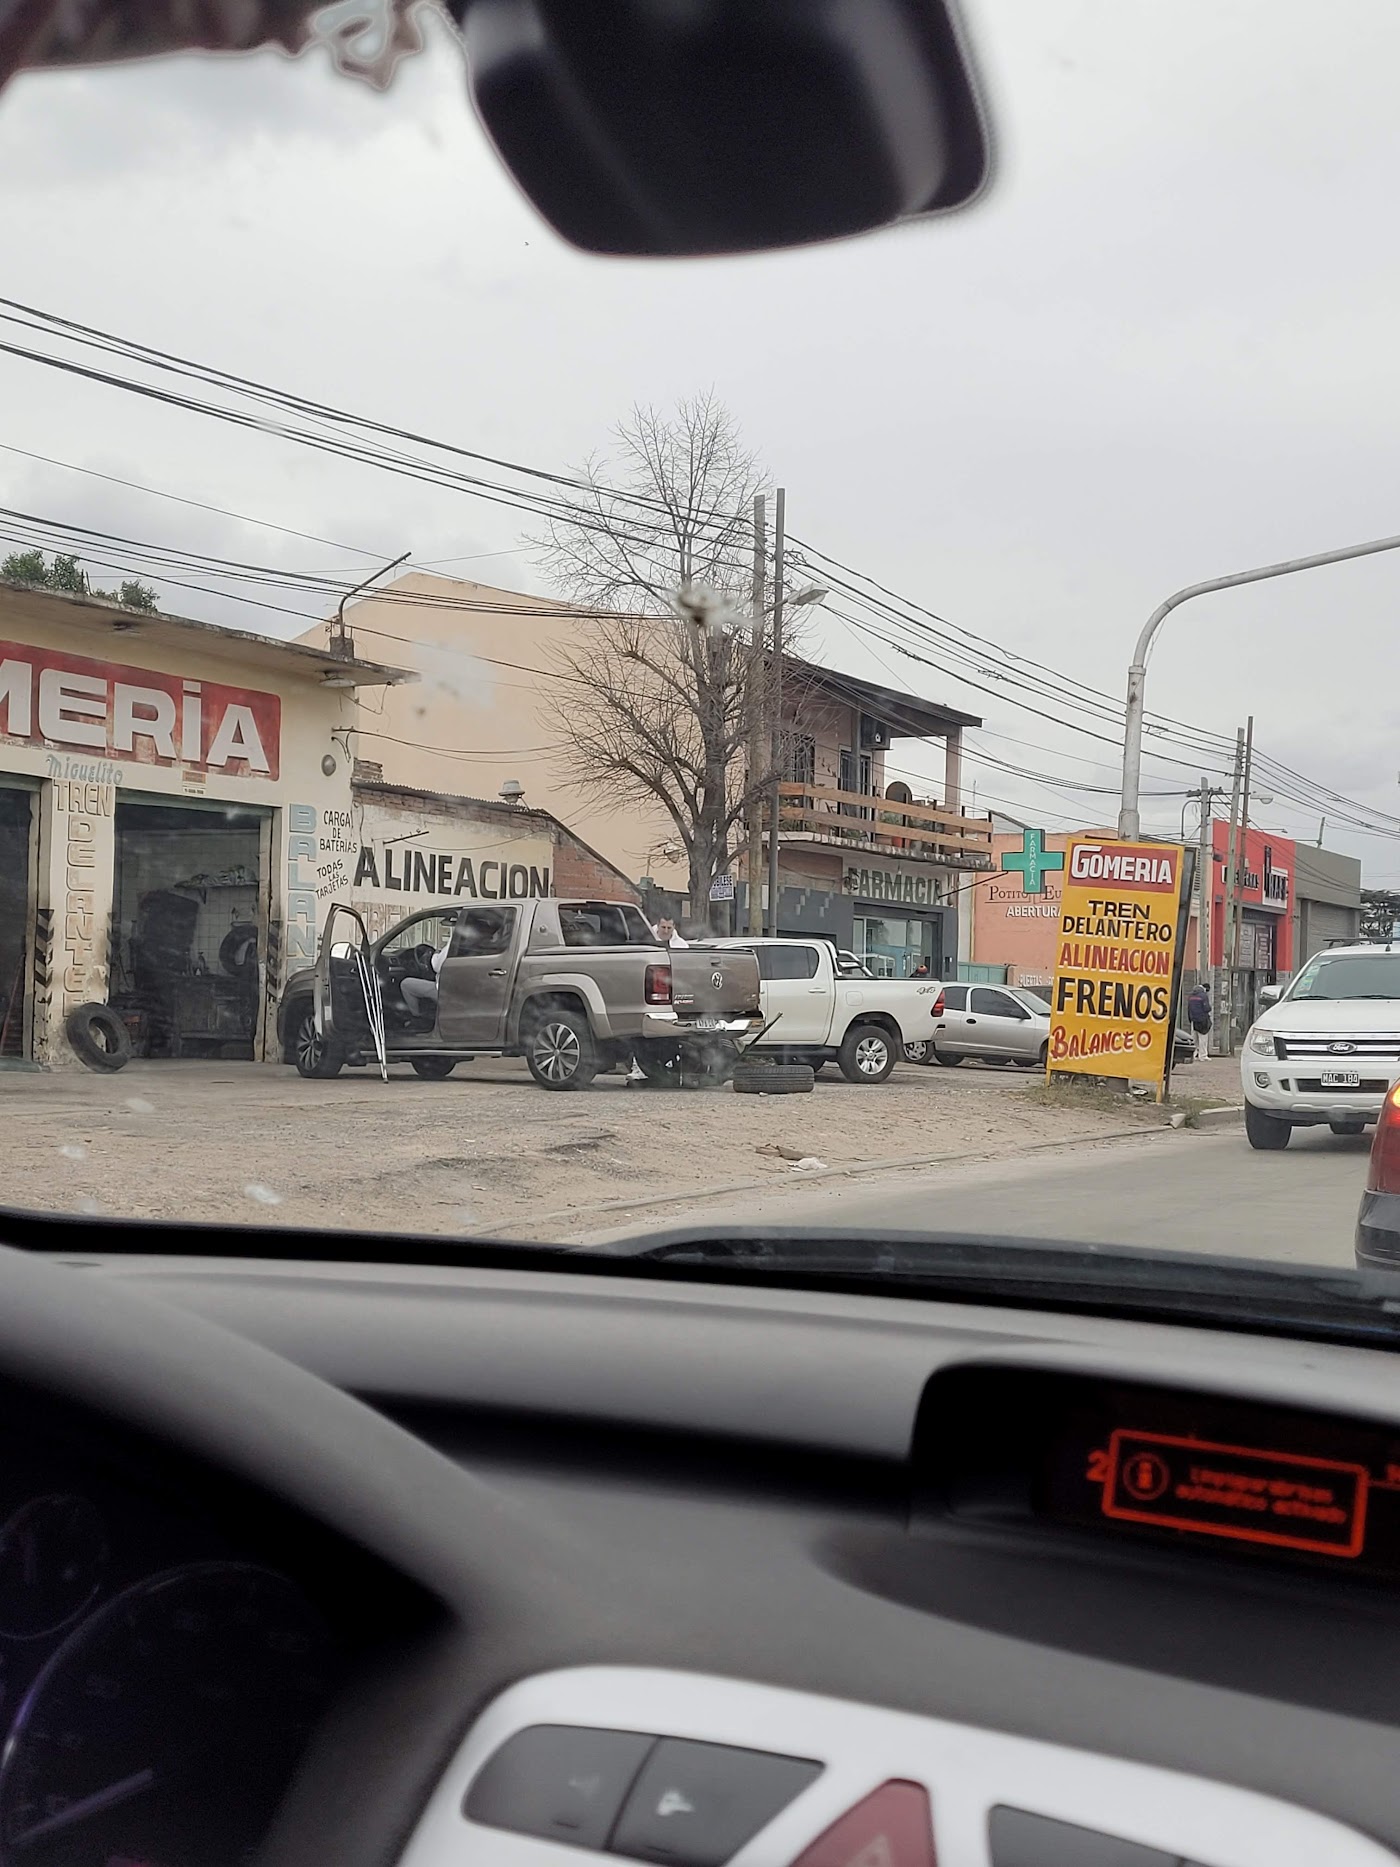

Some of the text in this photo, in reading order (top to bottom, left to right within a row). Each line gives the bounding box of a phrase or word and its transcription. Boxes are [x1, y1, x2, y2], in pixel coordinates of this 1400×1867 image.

[53, 780, 113, 817] TREN
[323, 810, 351, 828] CARGA
[332, 827, 341, 839] DE
[316, 858, 344, 879] TODAS
[353, 845, 550, 899] ALINEACION
[1029, 833, 1037, 886] FARMACIA
[1071, 844, 1173, 884] GOMERIA
[315, 874, 349, 900] TARJETAS
[328, 871, 340, 882] LAS
[1087, 899, 1151, 922] TREN
[1061, 915, 1173, 944] DELANTERO
[1058, 942, 1170, 977] ALINEACION
[1056, 976, 1169, 1023] FRENOS
